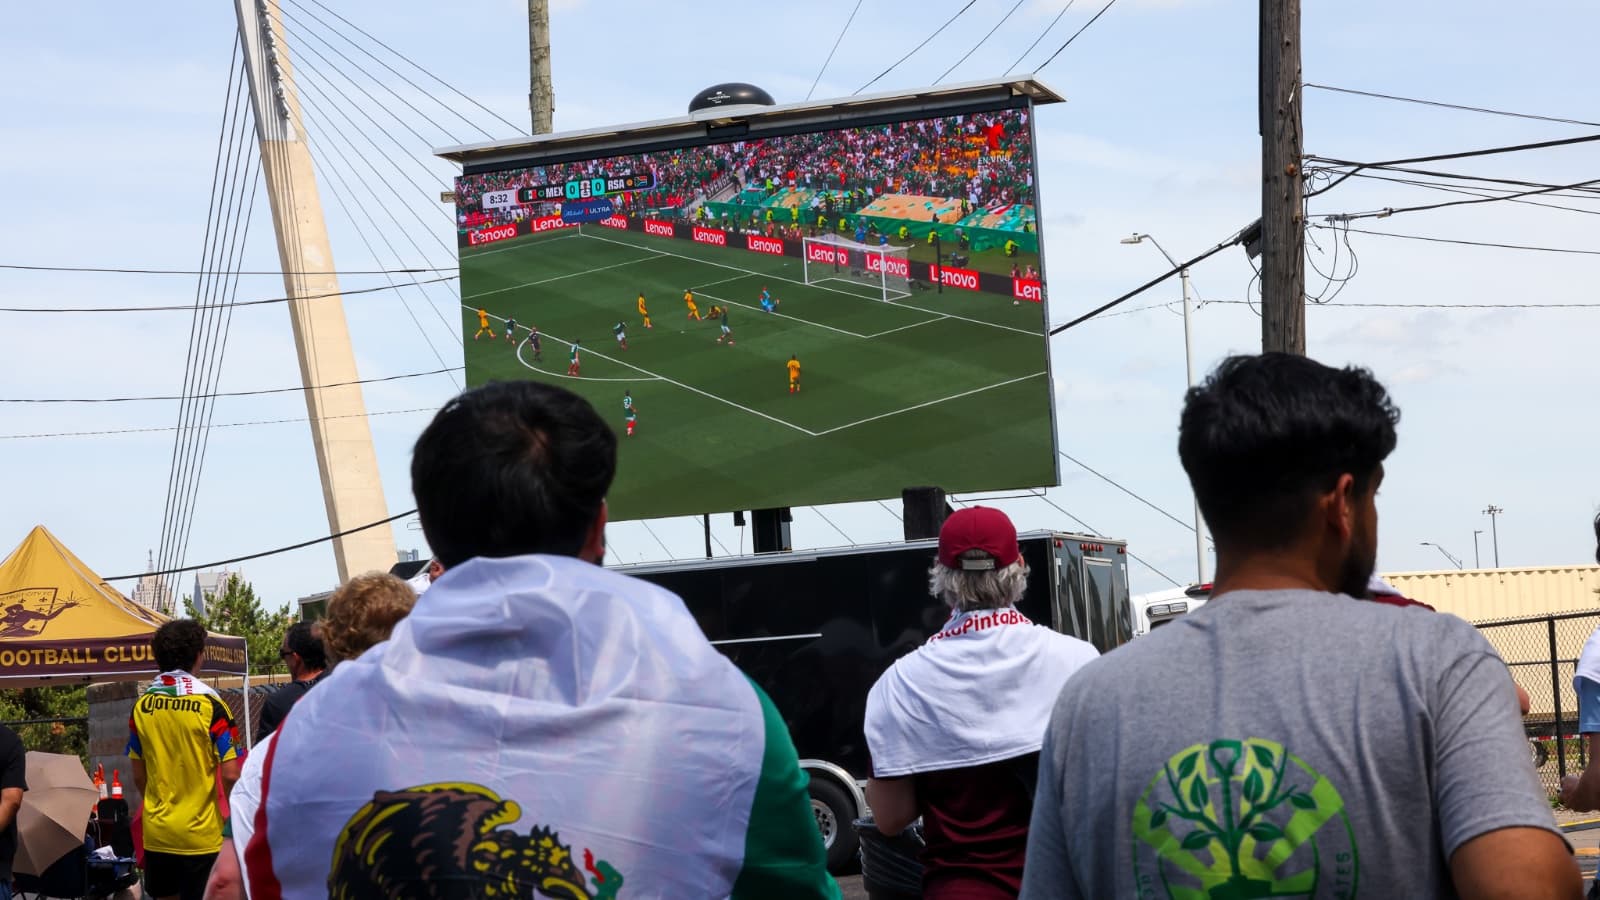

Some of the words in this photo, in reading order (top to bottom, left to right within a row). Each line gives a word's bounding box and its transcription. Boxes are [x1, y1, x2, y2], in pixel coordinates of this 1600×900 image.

[489, 193, 508, 204] 8:32
[545, 186, 564, 198] MEX
[595, 182, 602, 192] 0
[607, 179, 625, 191] RSA
[589, 206, 611, 215] ULTRA
[534, 218, 578, 231] Leno
[645, 221, 673, 236] Lenovo
[693, 228, 725, 244] Lenovo
[748, 237, 782, 253] Lenovo
[1015, 279, 1042, 300] Len
[0, 647, 98, 667] OOTBALL
[141, 694, 202, 715] Corona
